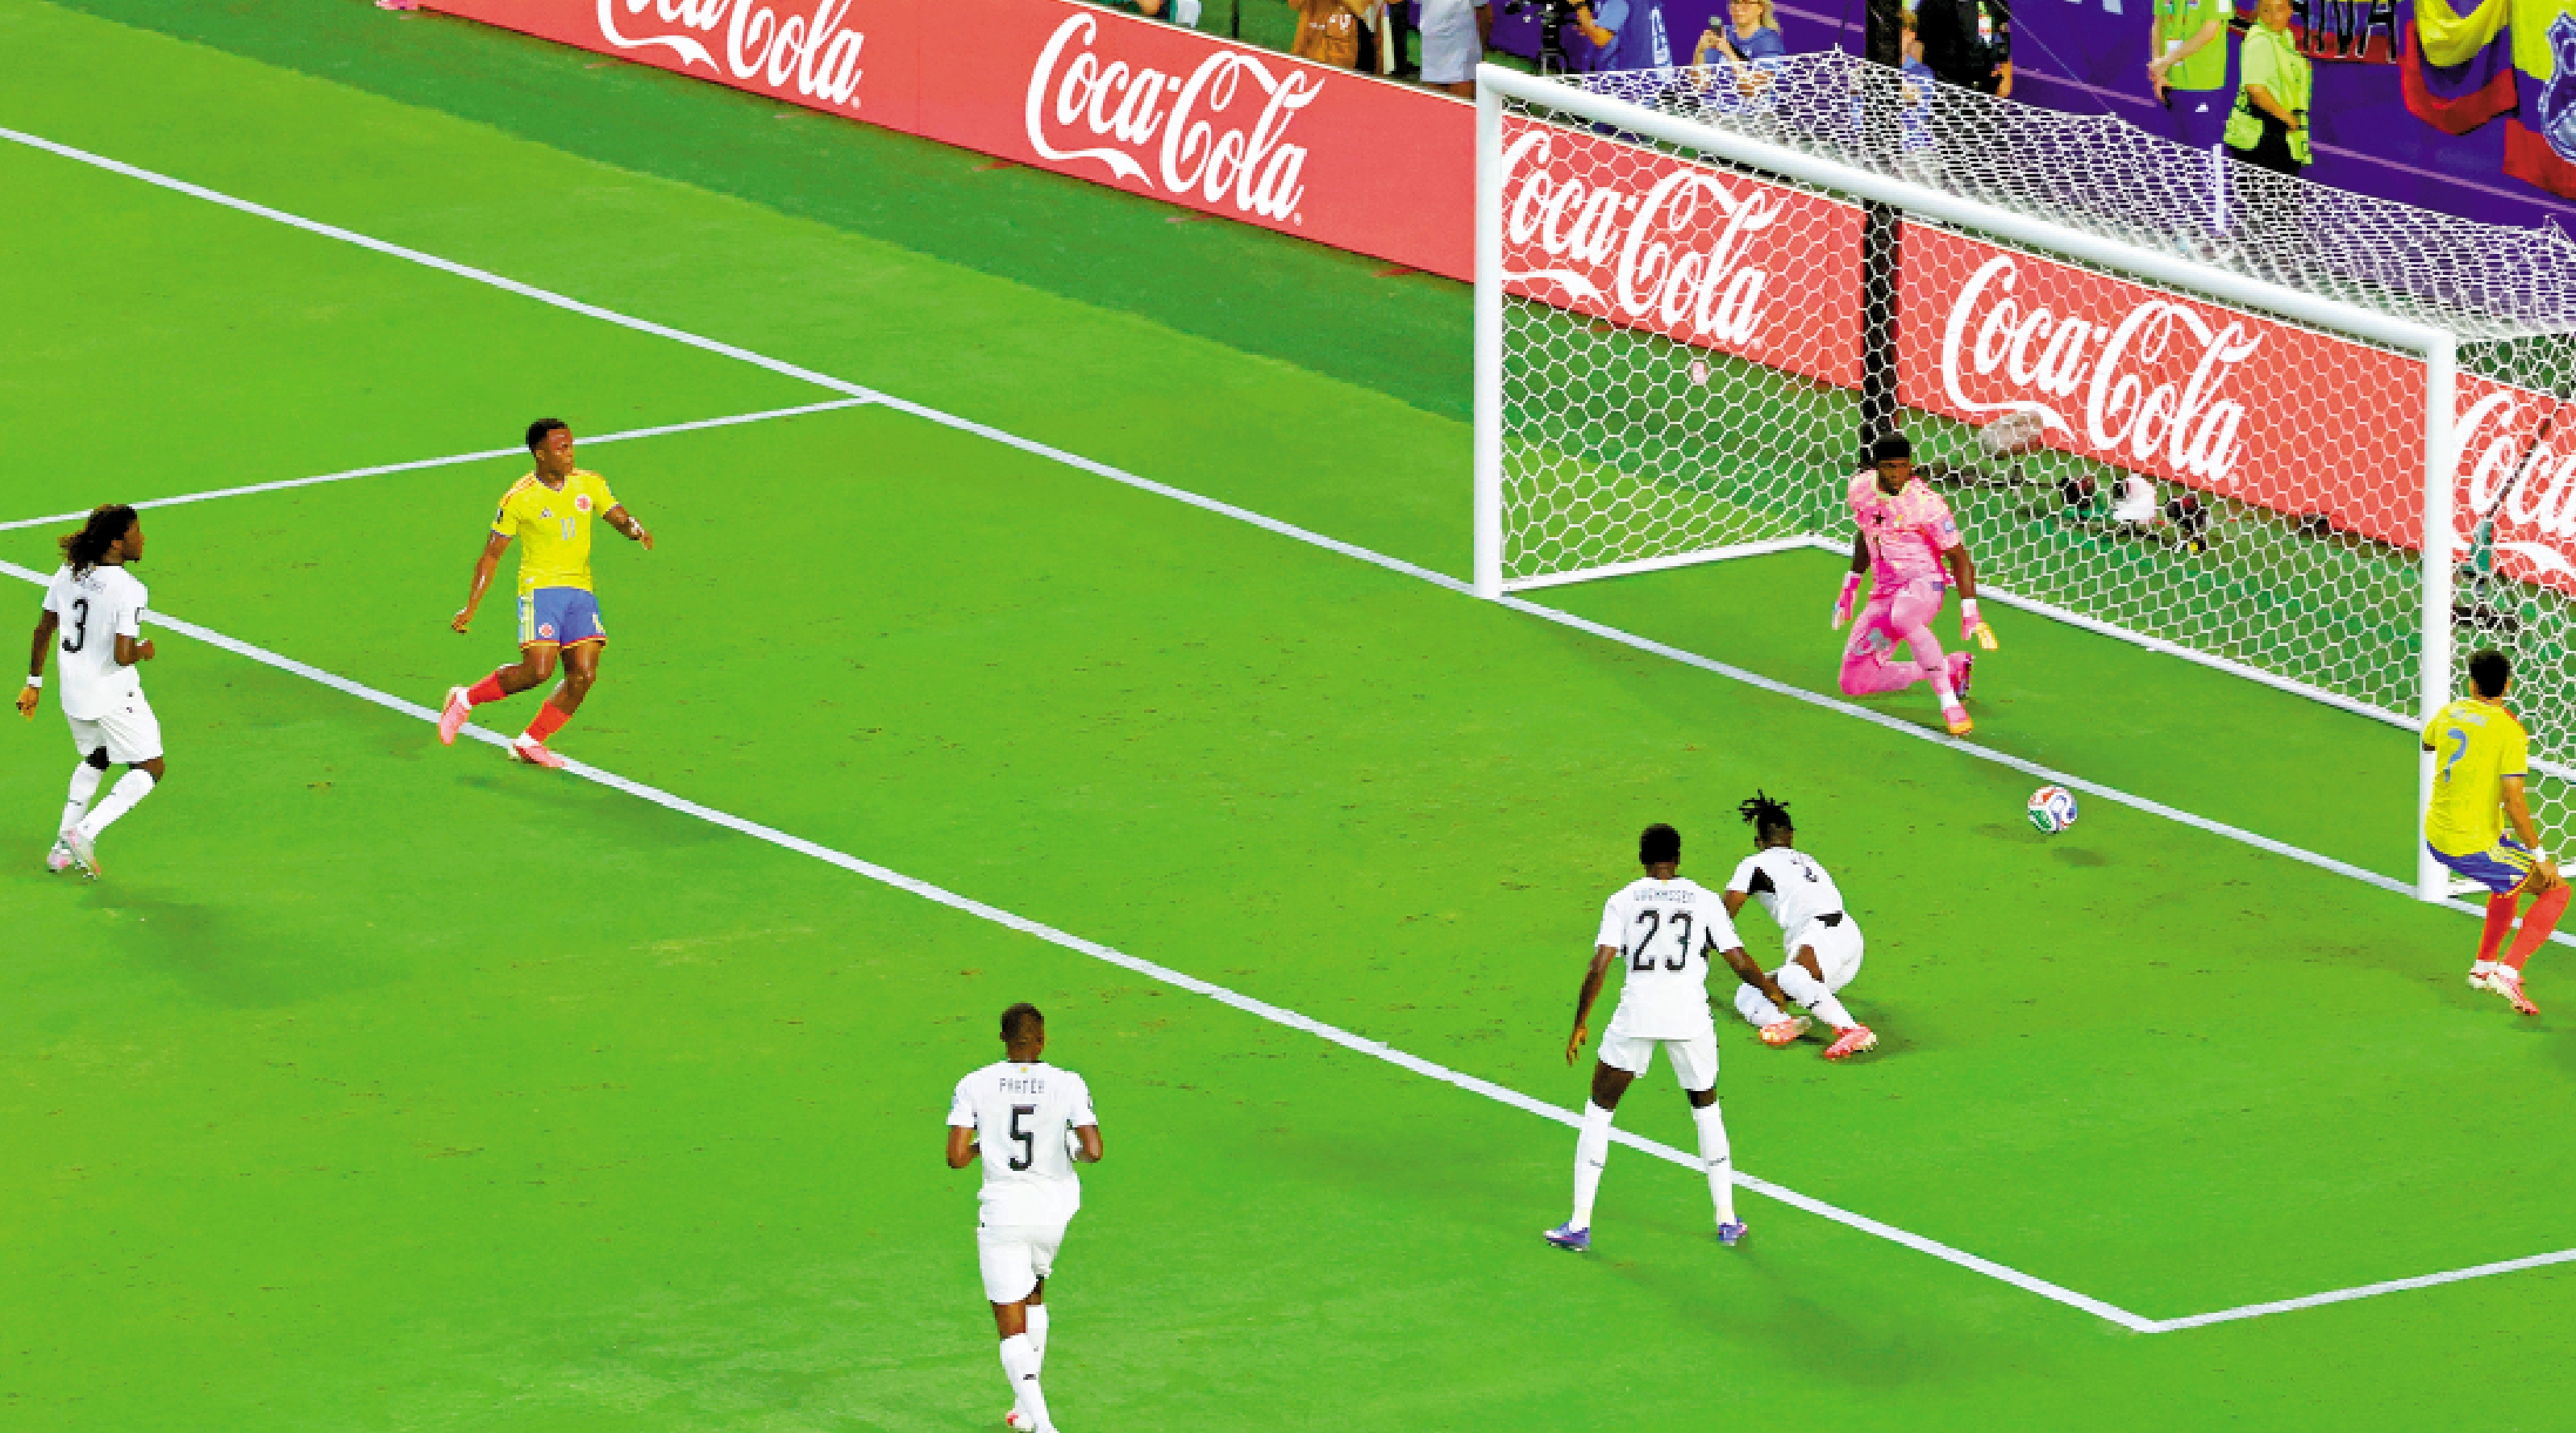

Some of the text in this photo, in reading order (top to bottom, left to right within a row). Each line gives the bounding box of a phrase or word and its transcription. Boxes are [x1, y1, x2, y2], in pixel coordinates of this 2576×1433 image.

[1026, 12, 1325, 221] Coca-Cola
[1941, 255, 2264, 481] Coca-Cola
[61, 598, 89, 654] 3
[1633, 908, 1694, 972] 23
[1009, 1103, 1037, 1172] 5
